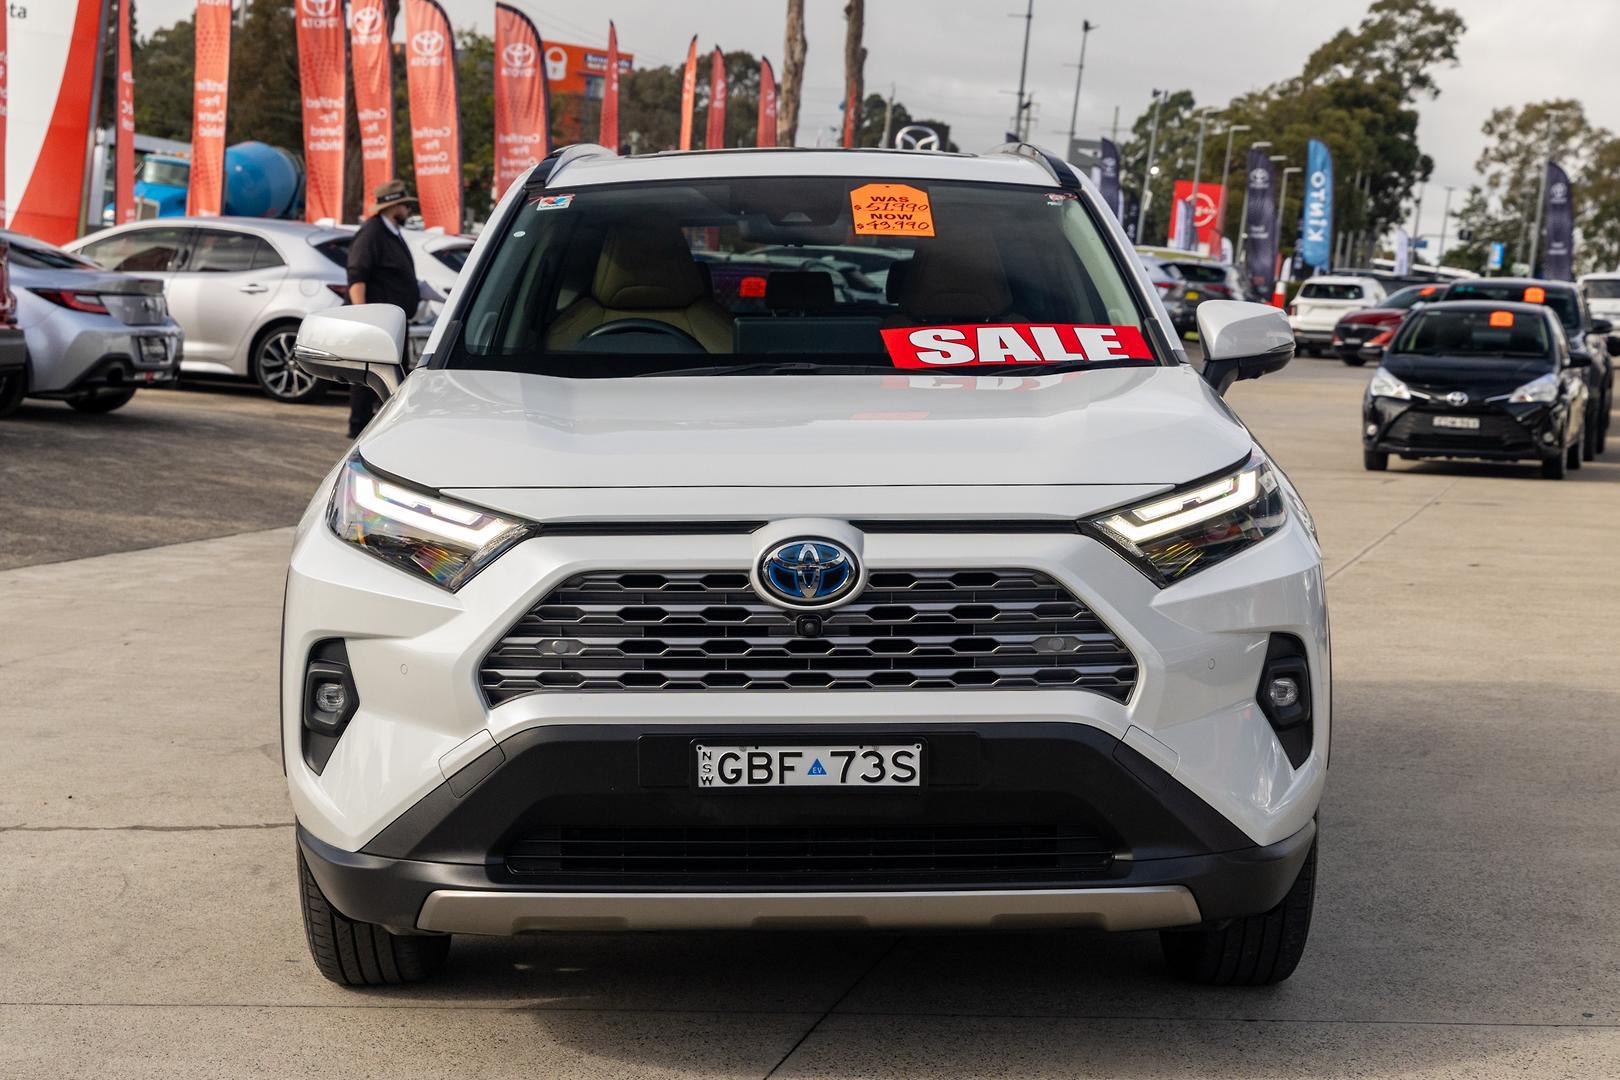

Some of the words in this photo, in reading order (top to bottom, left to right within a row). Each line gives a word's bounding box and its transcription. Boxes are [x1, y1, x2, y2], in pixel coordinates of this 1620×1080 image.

[908, 325, 1130, 365] SALE
[717, 751, 803, 785] GBF
[829, 750, 917, 783] 73S
